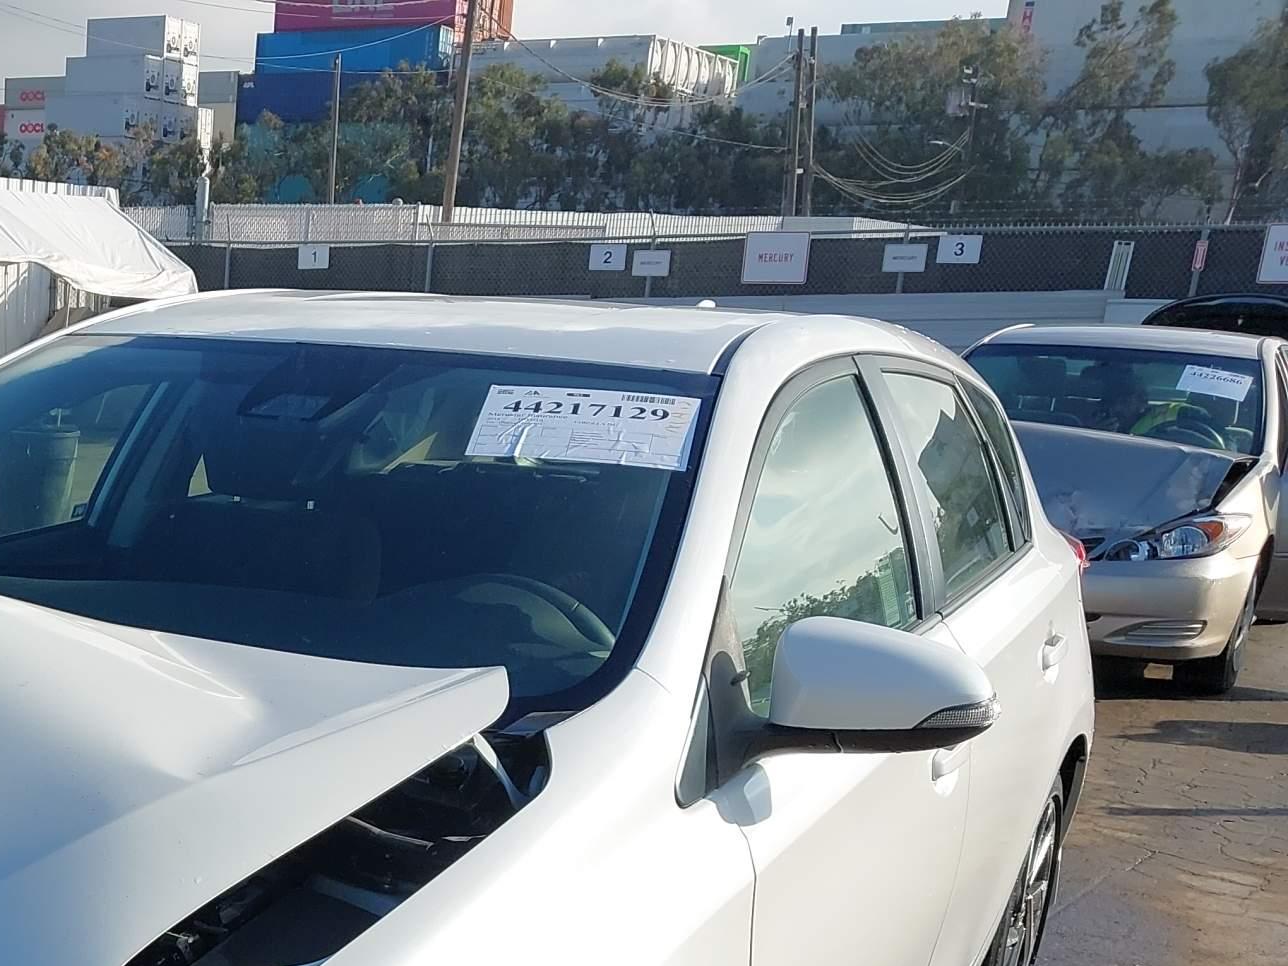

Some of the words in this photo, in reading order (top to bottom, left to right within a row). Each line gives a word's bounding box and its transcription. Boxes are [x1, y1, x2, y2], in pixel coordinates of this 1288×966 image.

[953, 242, 965, 256] 3
[311, 250, 317, 263] 1
[602, 251, 613, 264] 2
[757, 252, 794, 263] MERCURY
[502, 399, 671, 421] 44217129
